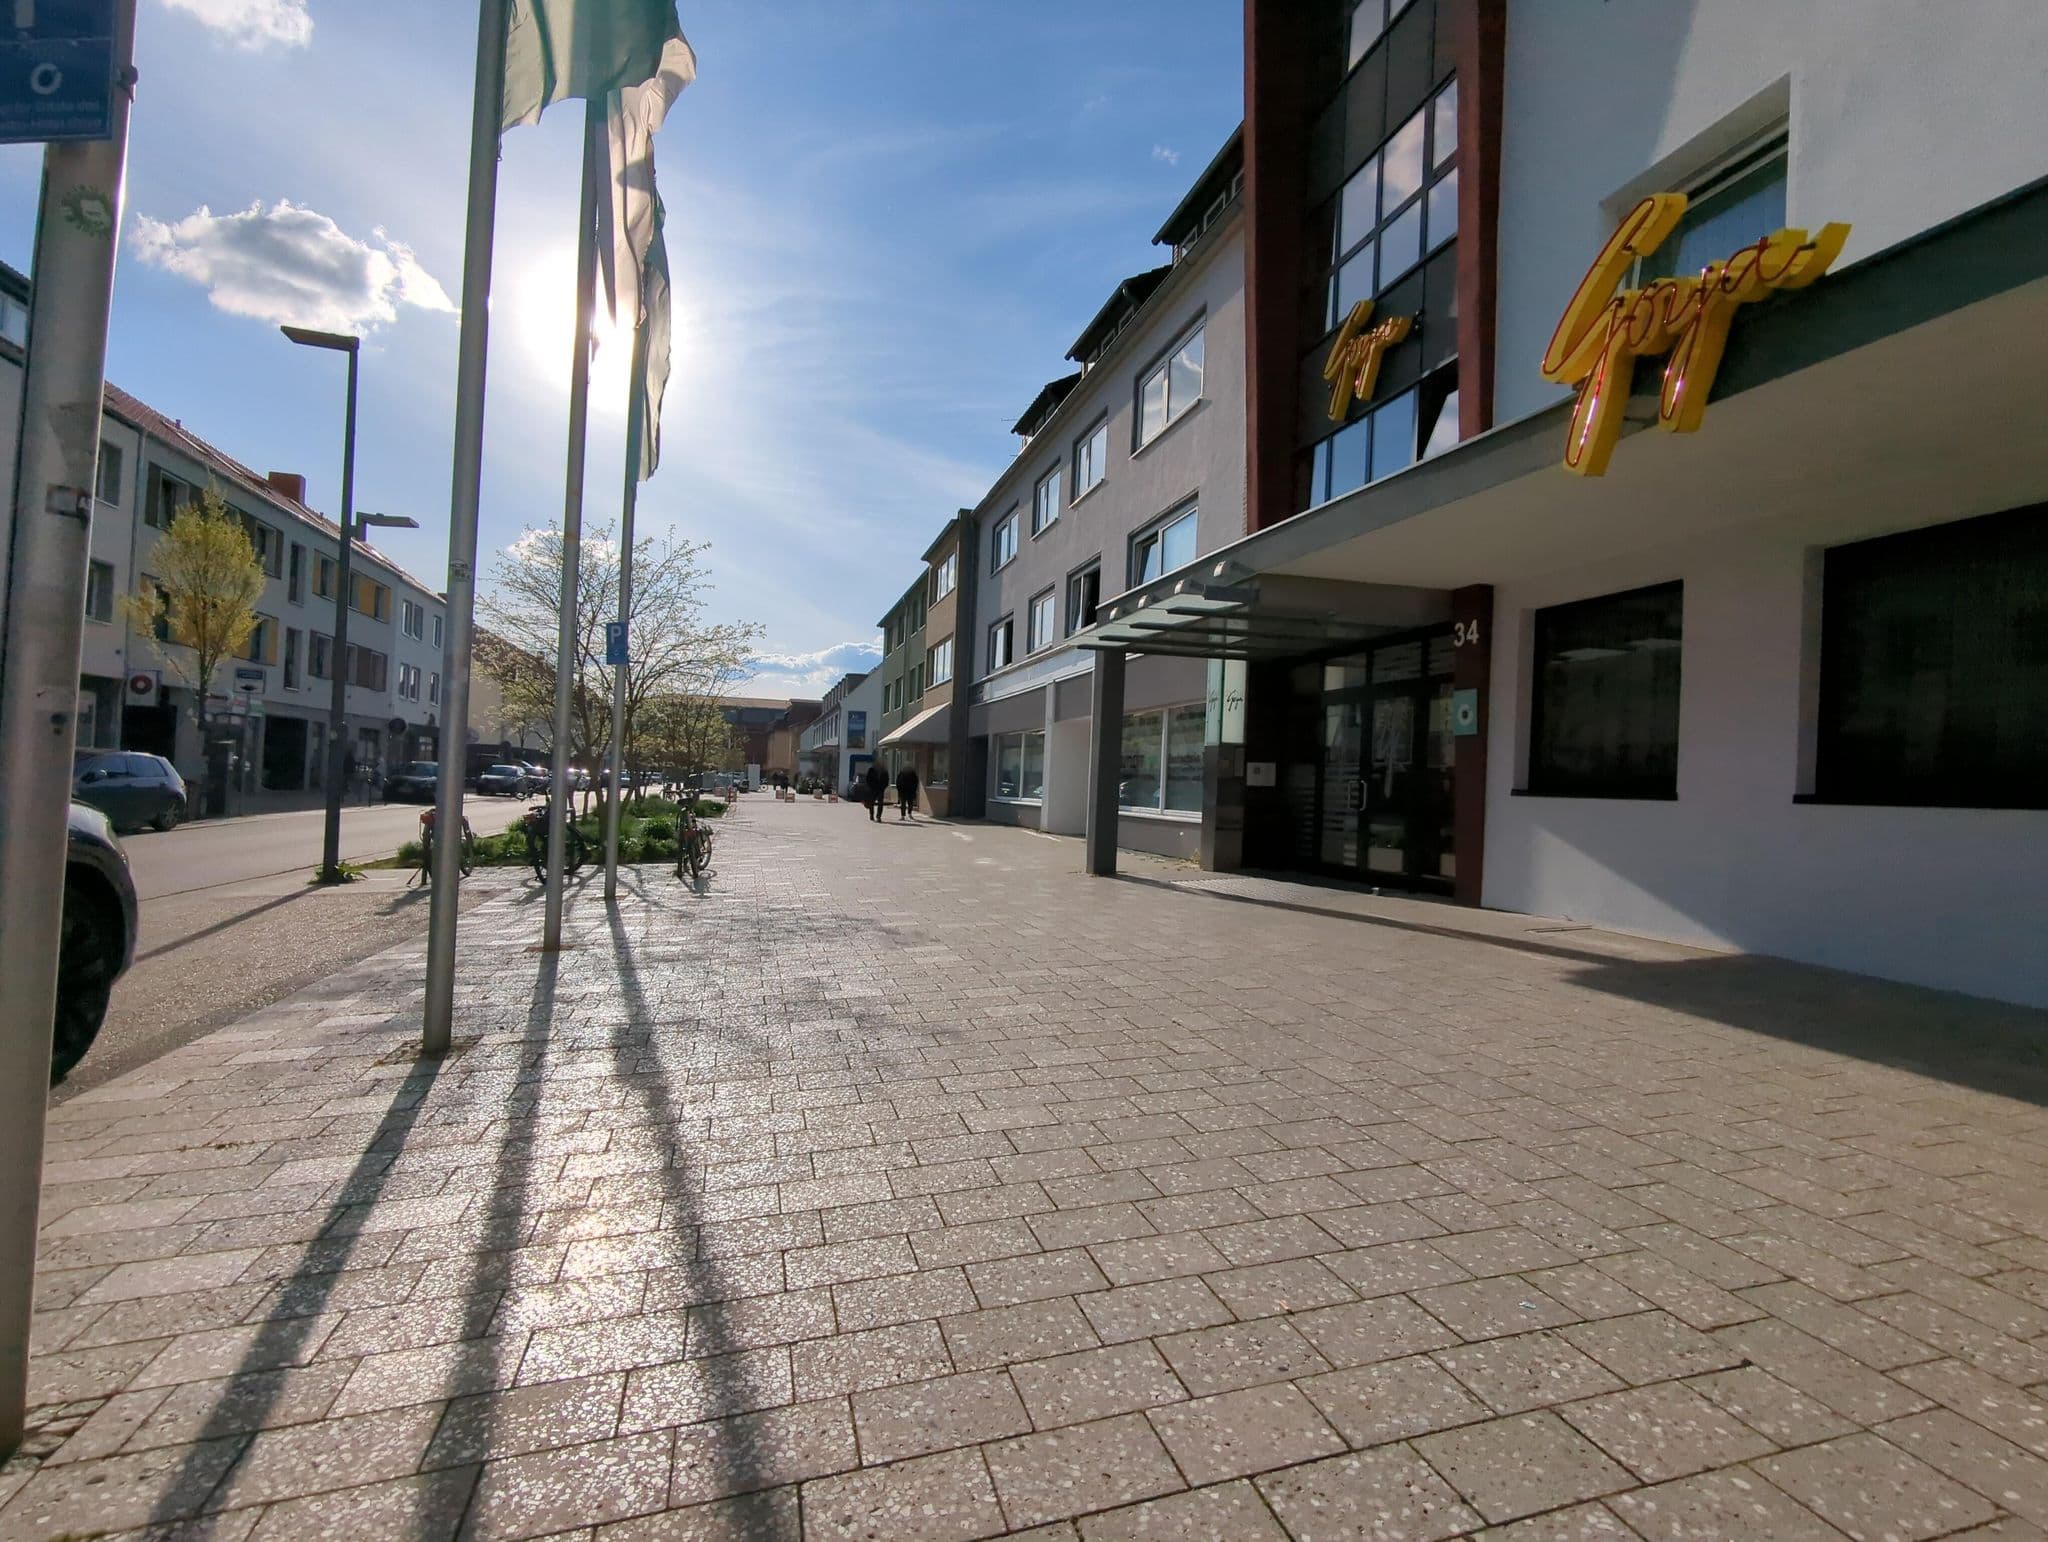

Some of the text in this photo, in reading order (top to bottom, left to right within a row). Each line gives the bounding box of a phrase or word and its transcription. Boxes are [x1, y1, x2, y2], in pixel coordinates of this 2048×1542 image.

[1323, 299, 1413, 421] Goya
[1541, 192, 1852, 476] Goya
[610, 625, 622, 644] P
[1454, 619, 1479, 647] 34
